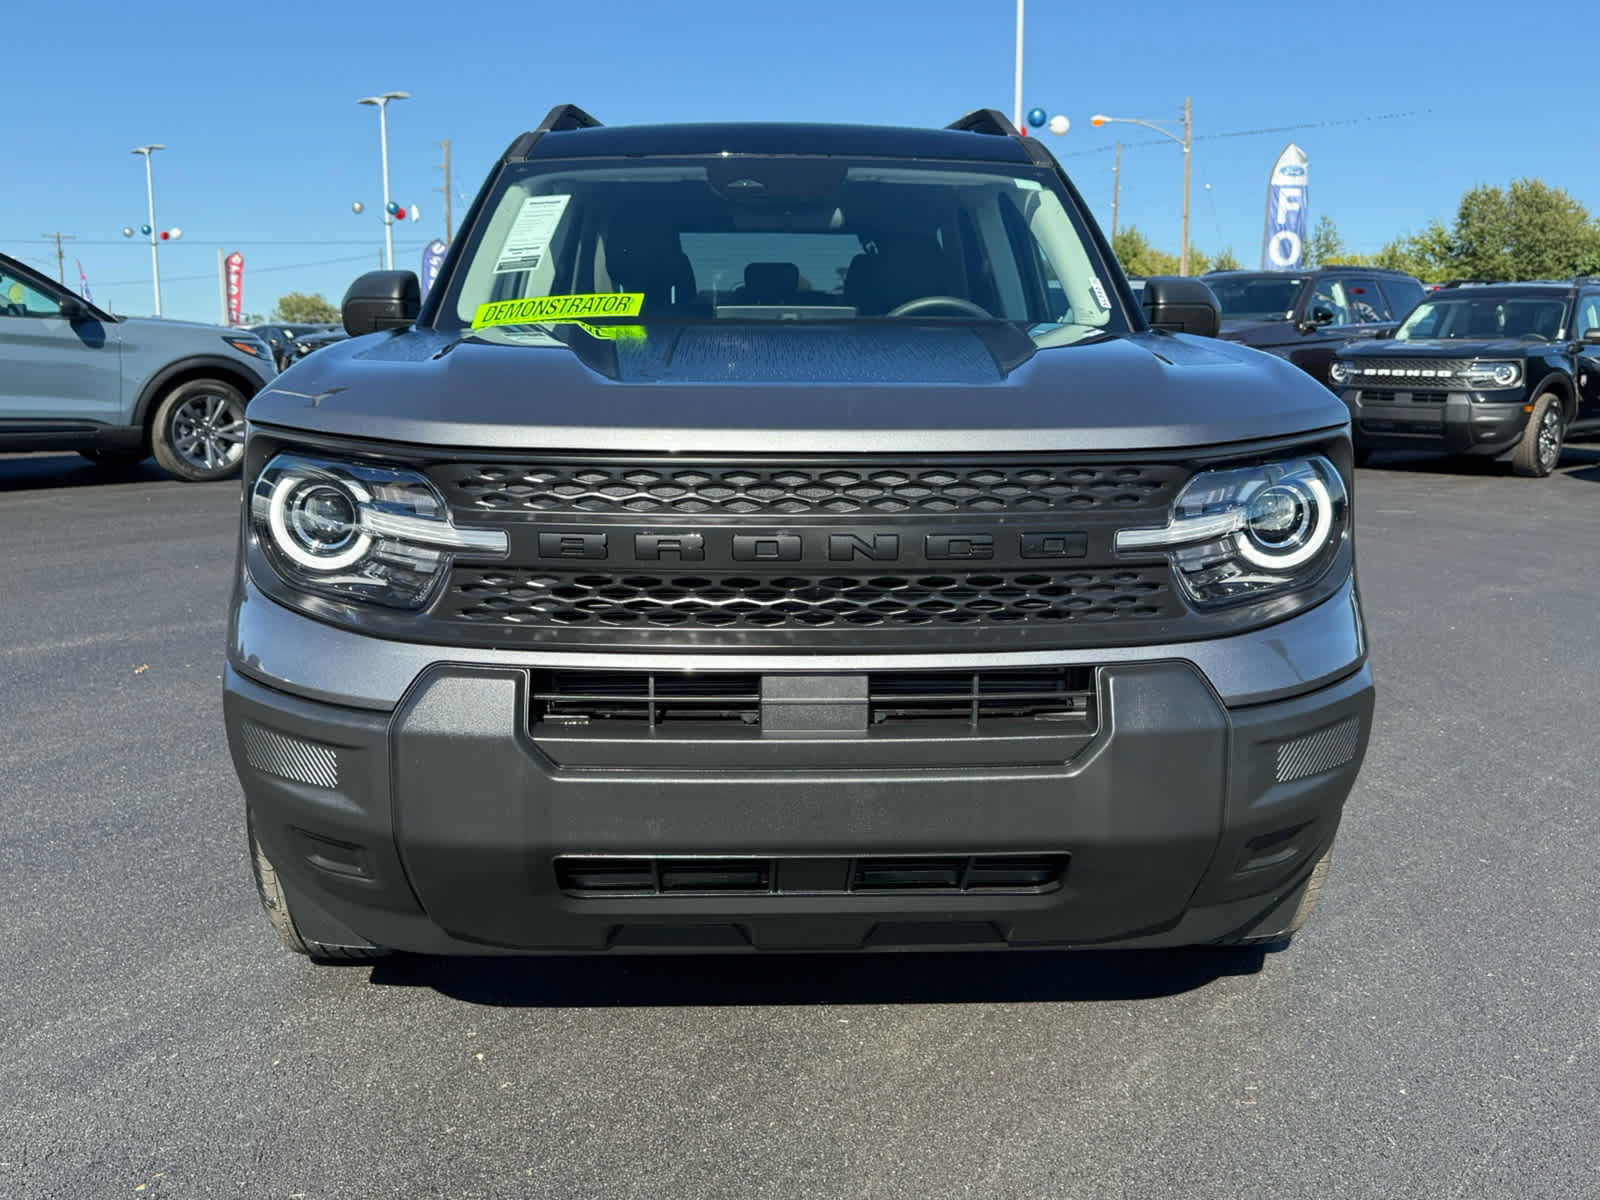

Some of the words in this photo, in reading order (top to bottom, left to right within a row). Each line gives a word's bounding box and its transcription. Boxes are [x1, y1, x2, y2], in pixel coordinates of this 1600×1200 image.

[482, 296, 631, 323] DEMONSTRATOR
[1364, 368, 1452, 378] BRONCO
[538, 531, 1088, 561] BRONCO
